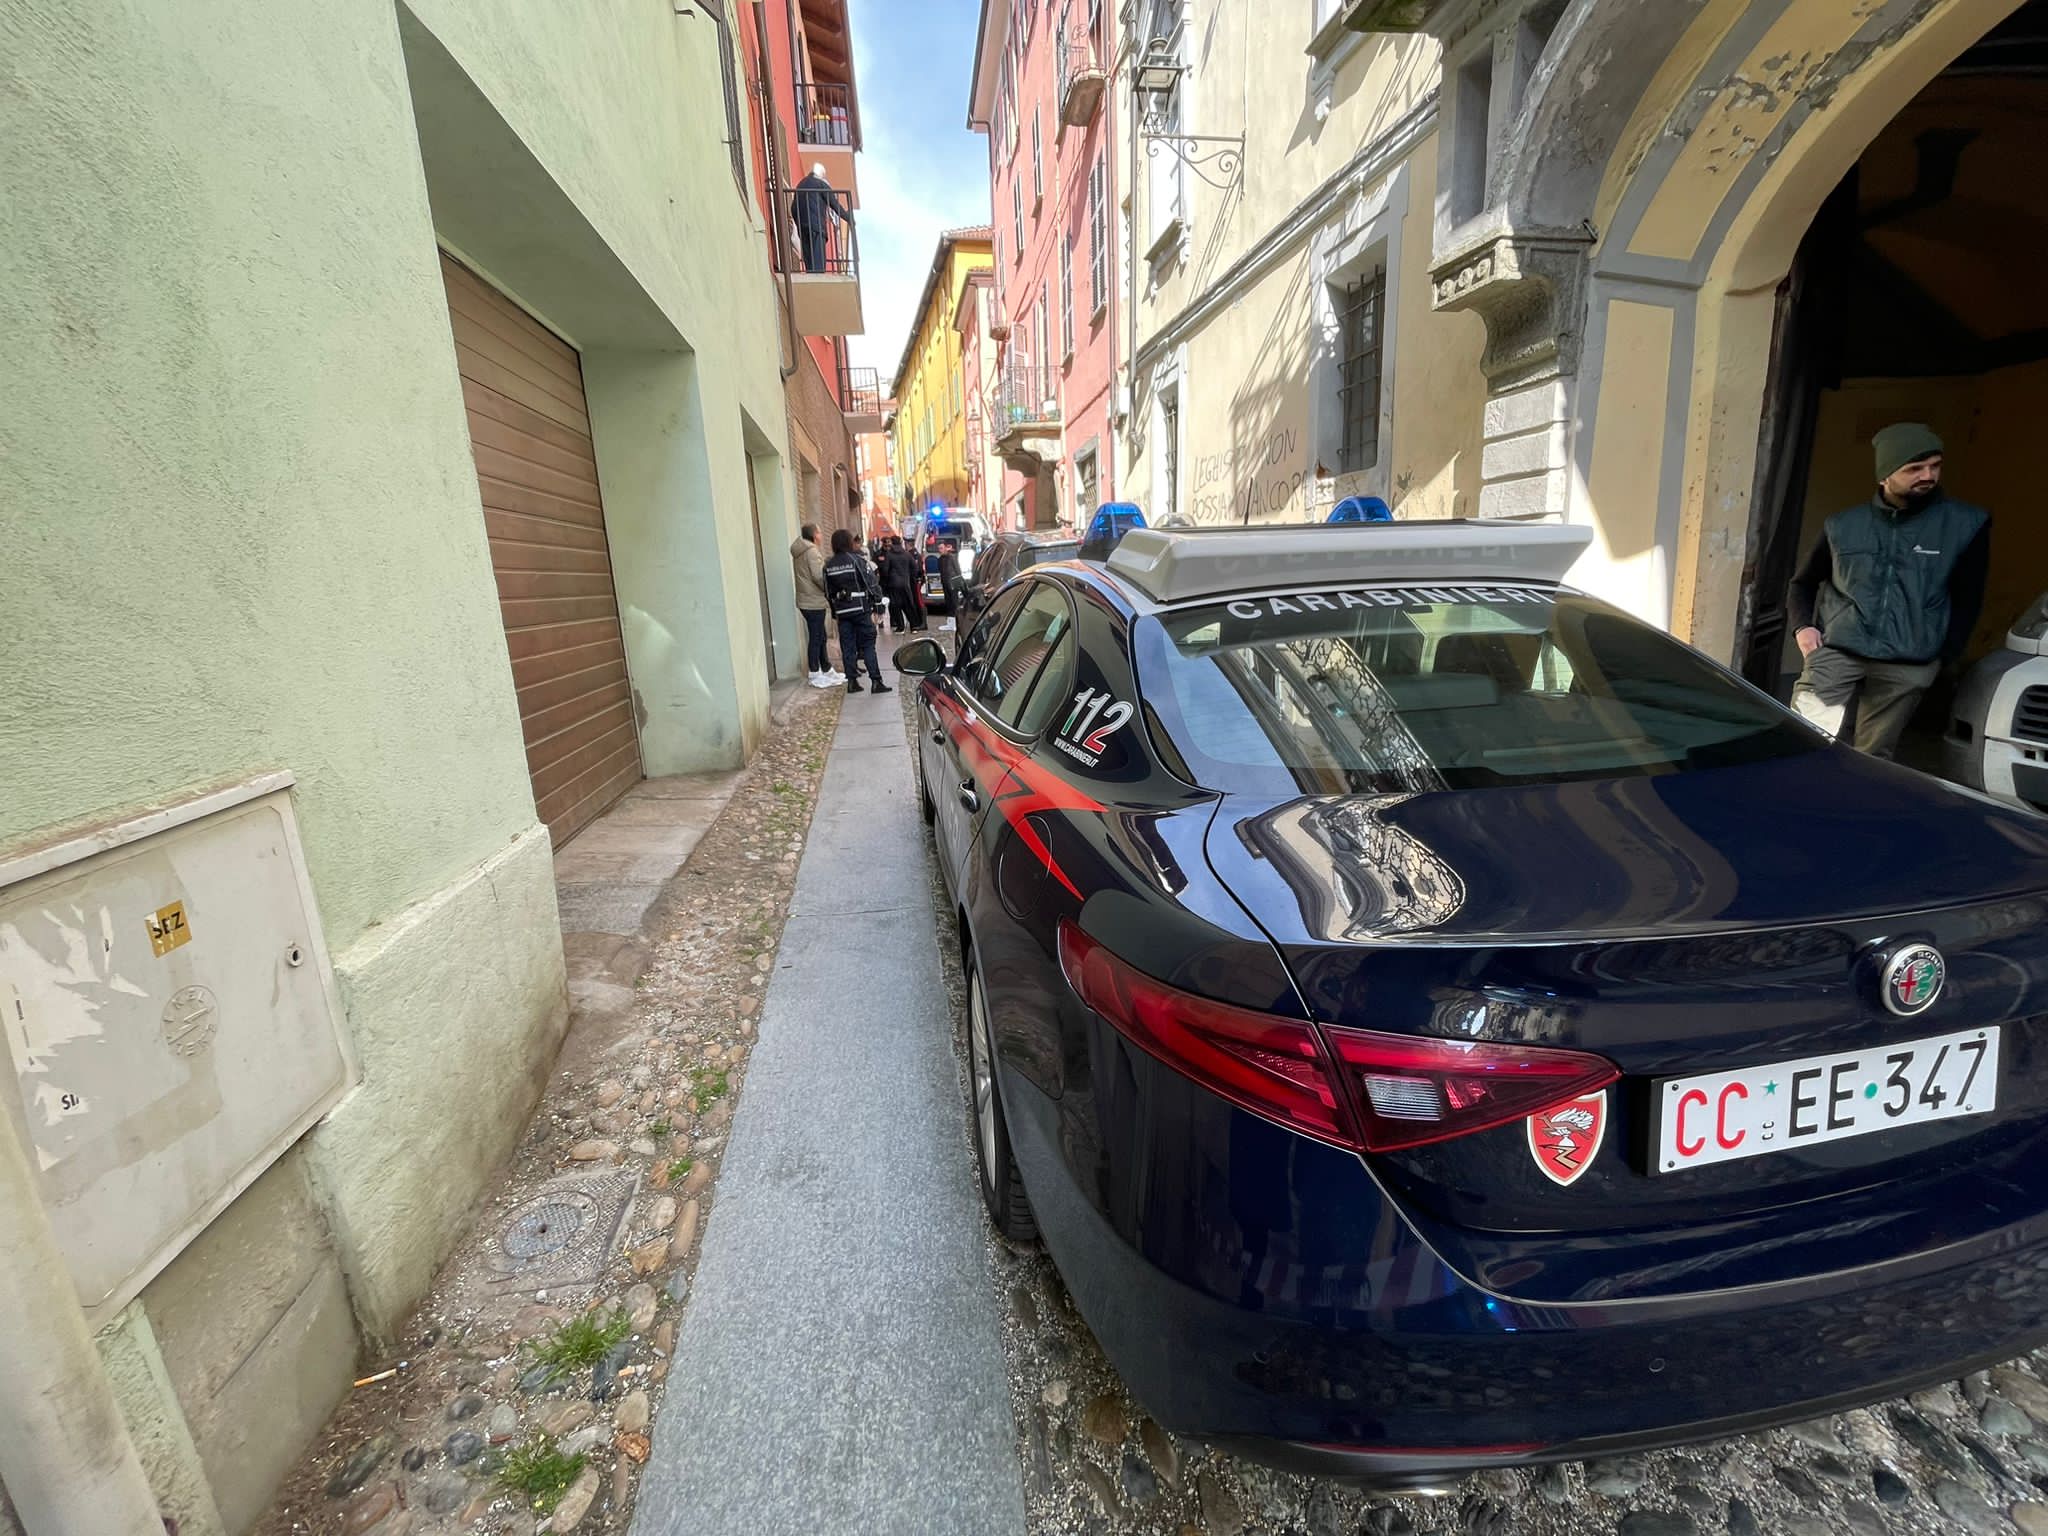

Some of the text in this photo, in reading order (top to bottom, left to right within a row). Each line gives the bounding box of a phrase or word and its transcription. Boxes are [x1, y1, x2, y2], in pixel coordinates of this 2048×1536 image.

[1262, 428, 1297, 466] NON
[1226, 587, 1556, 620] CARABINIERI
[1060, 687, 1134, 755] 112
[1675, 1039, 1989, 1157] CC EE 347
